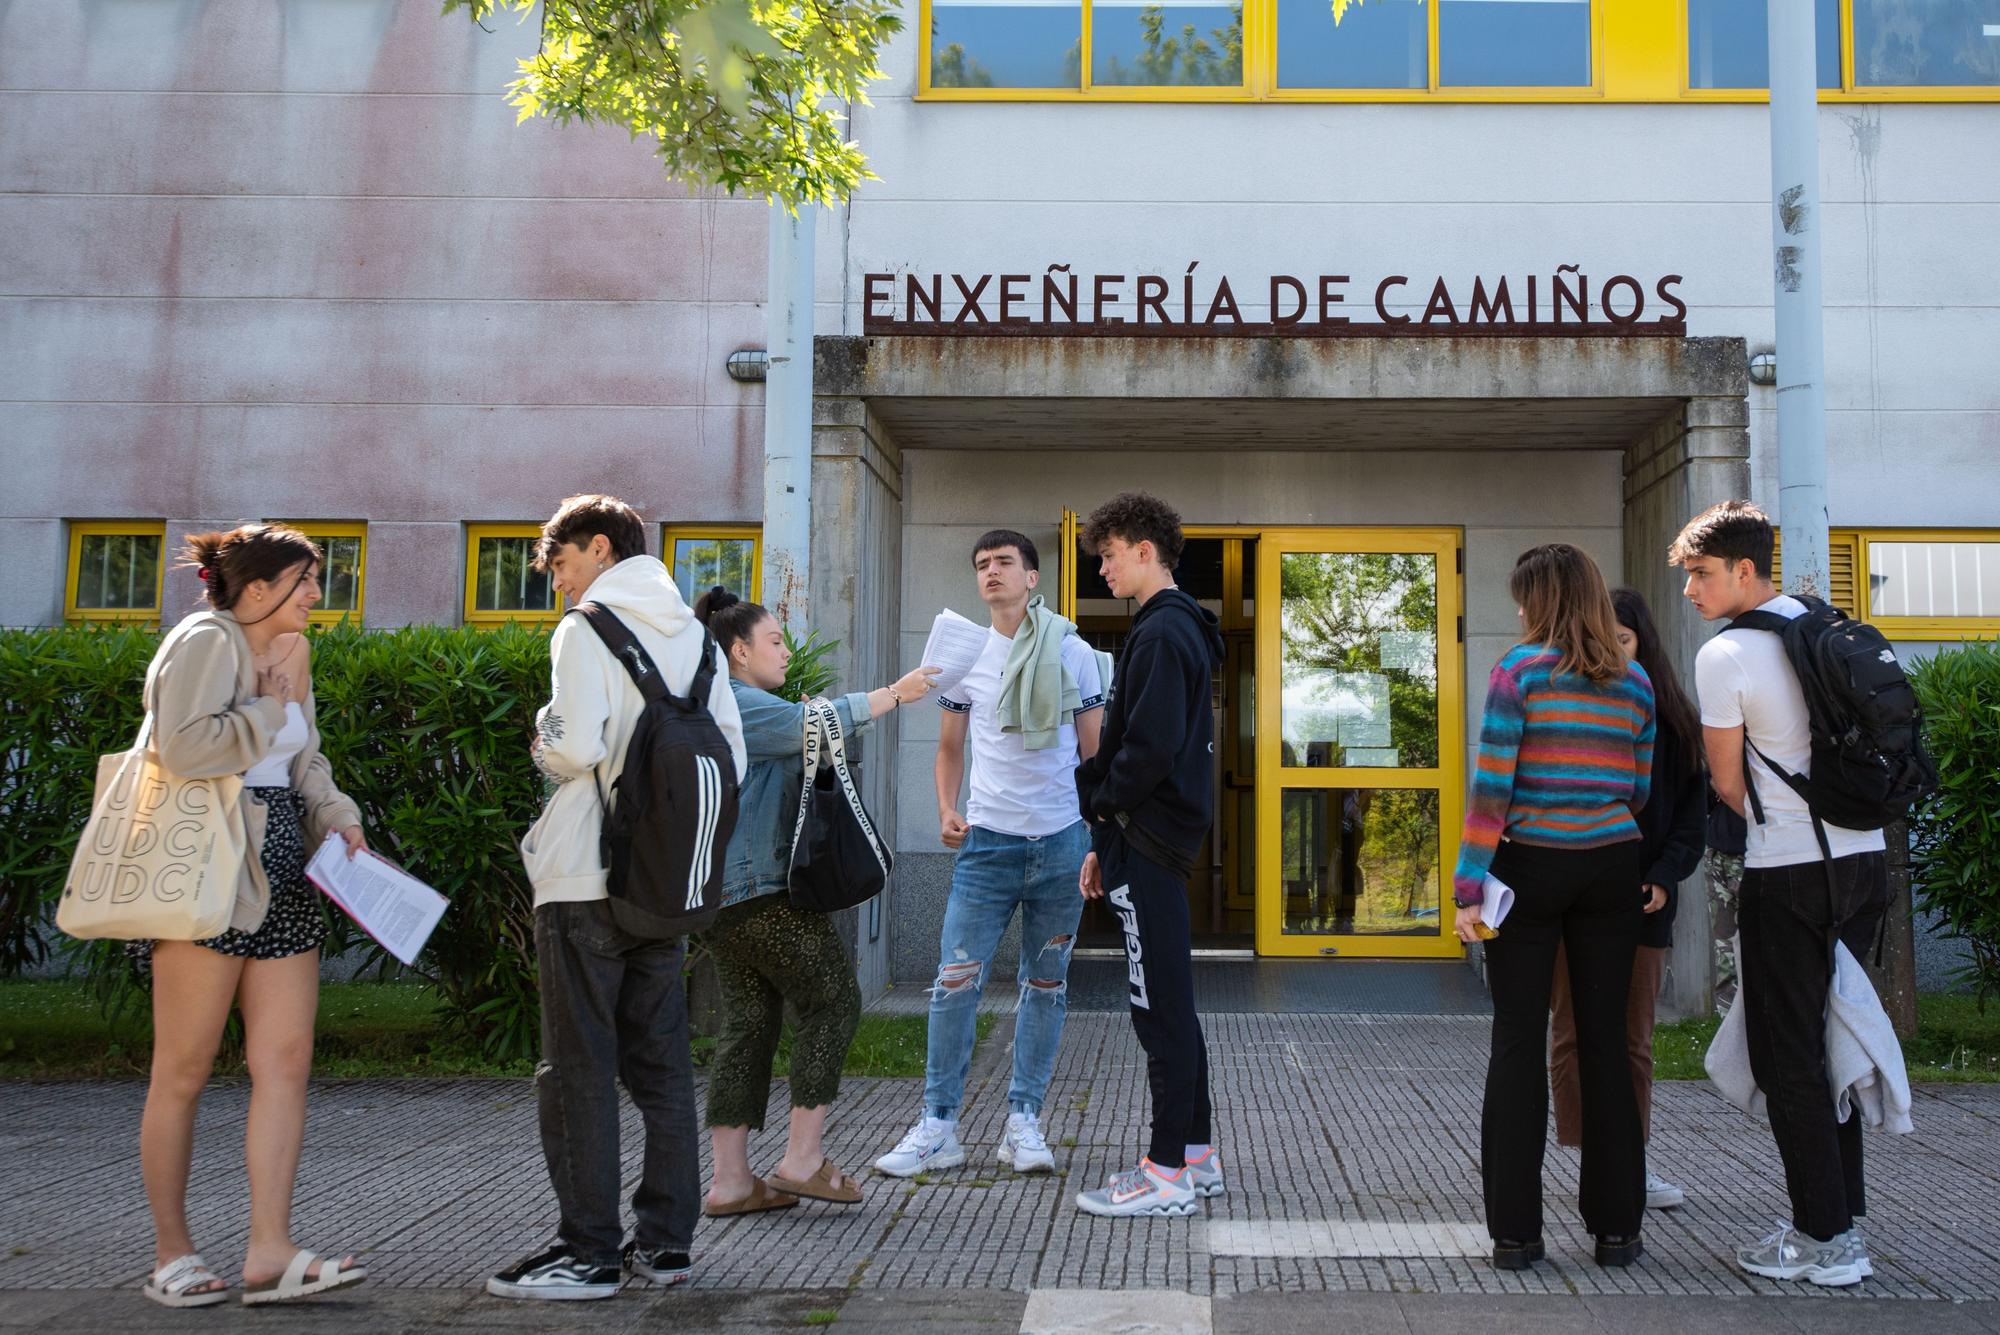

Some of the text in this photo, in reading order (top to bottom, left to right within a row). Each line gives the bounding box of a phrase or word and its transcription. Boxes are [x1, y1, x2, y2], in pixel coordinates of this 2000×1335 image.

[864, 261, 1687, 324] ENXEÑERÍA DE CAMIÑOS
[107, 772, 210, 816] UDC
[93, 816, 205, 858] UDC
[80, 862, 192, 904] UDC
[1109, 884, 1150, 1010] LEGEA
